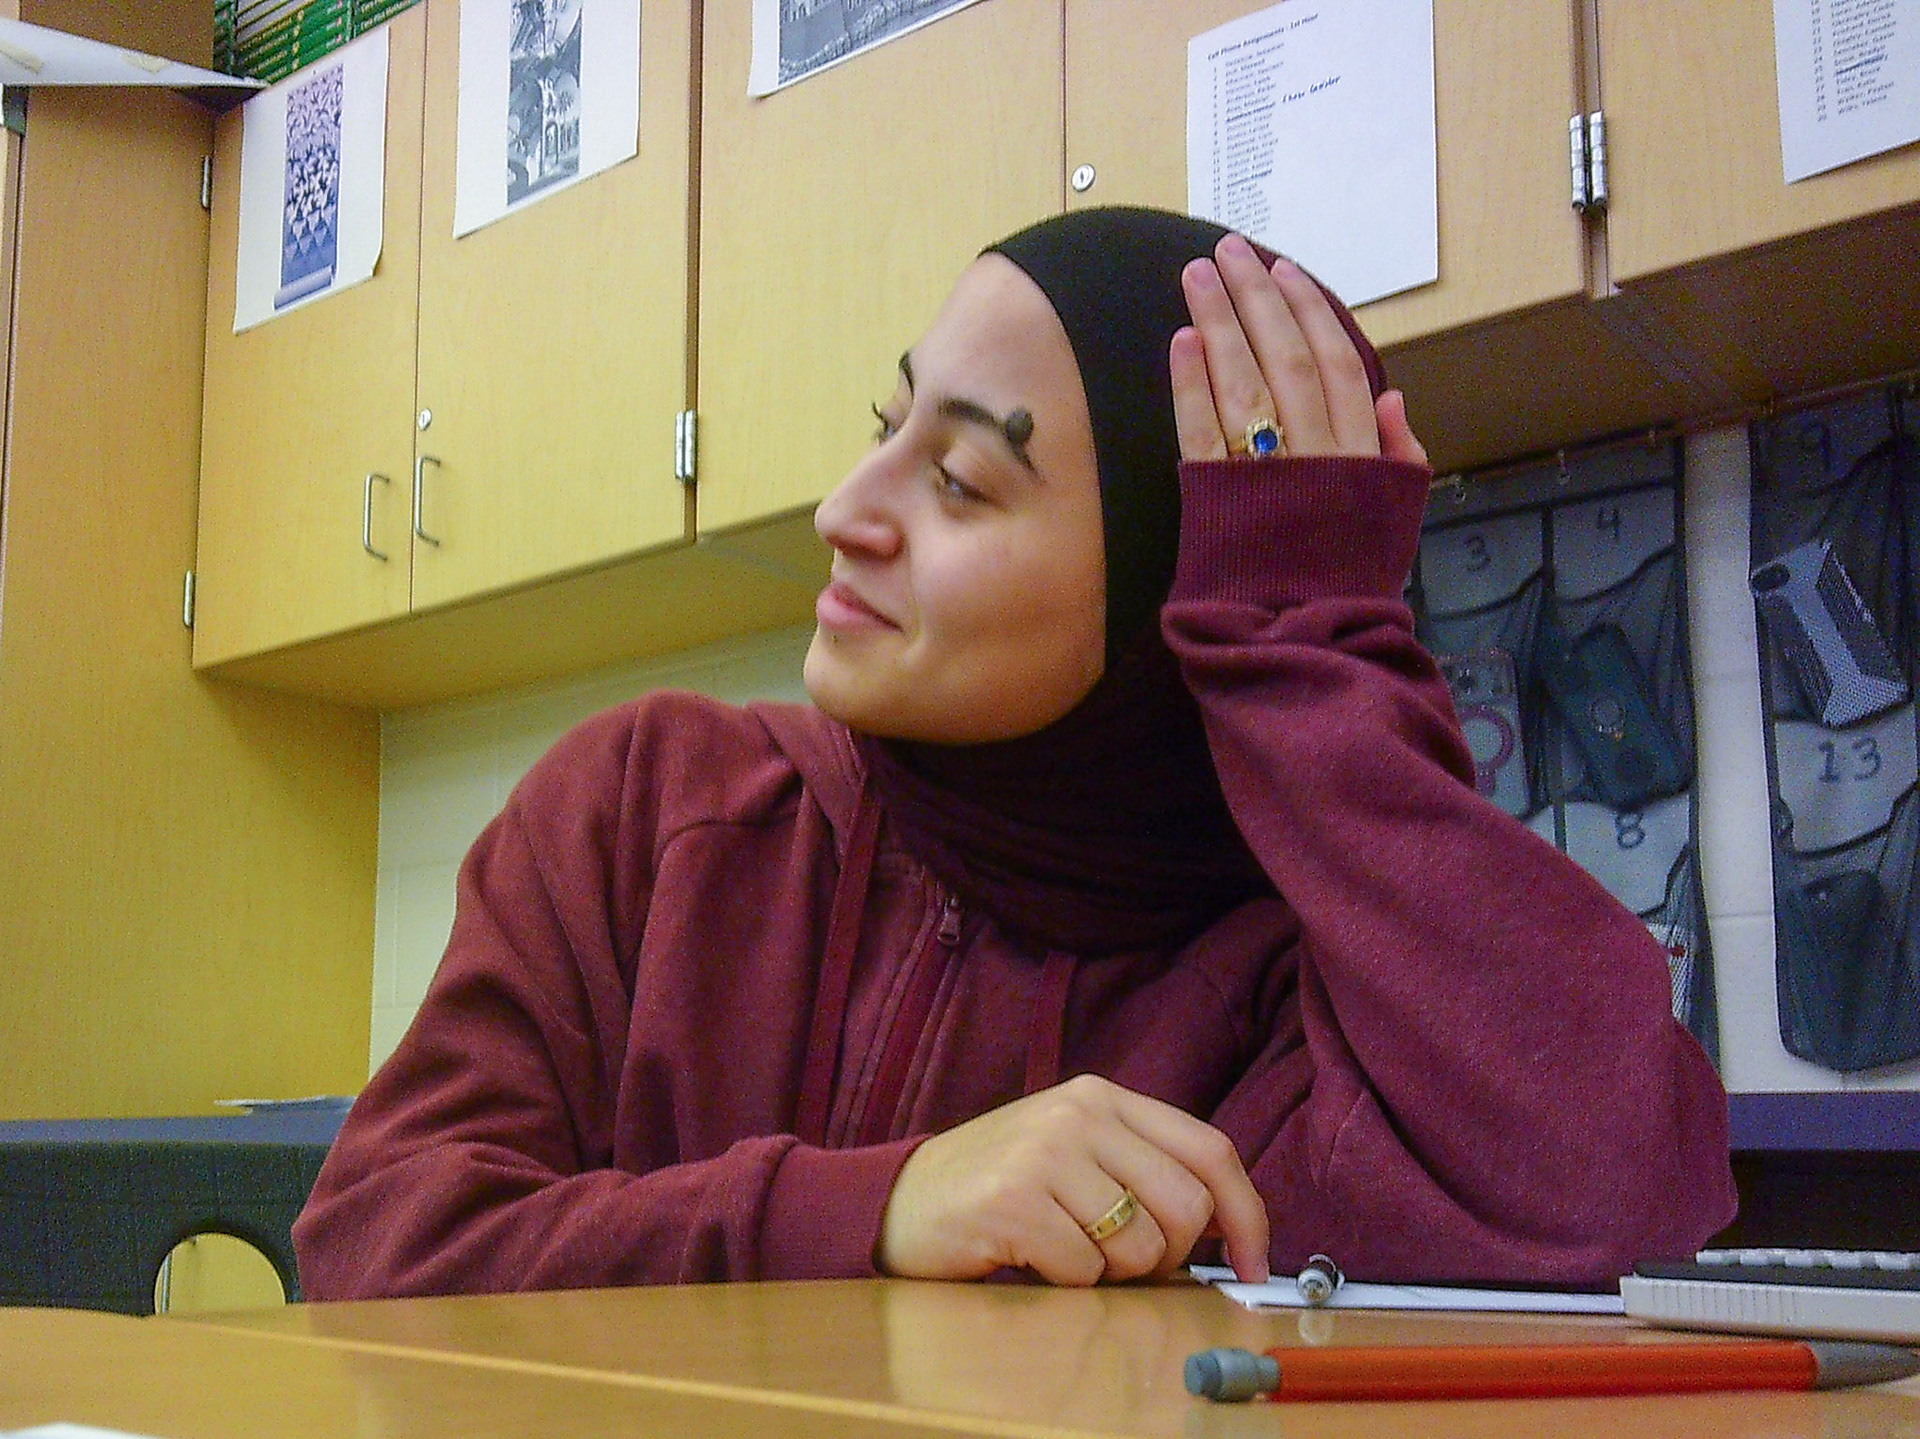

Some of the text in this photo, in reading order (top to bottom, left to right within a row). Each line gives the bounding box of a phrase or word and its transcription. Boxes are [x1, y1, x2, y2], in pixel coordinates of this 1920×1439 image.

[1596, 505, 1621, 543] 4
[1462, 534, 1492, 572] 3
[1816, 736, 1883, 785] 13
[1615, 809, 1647, 851] 8
